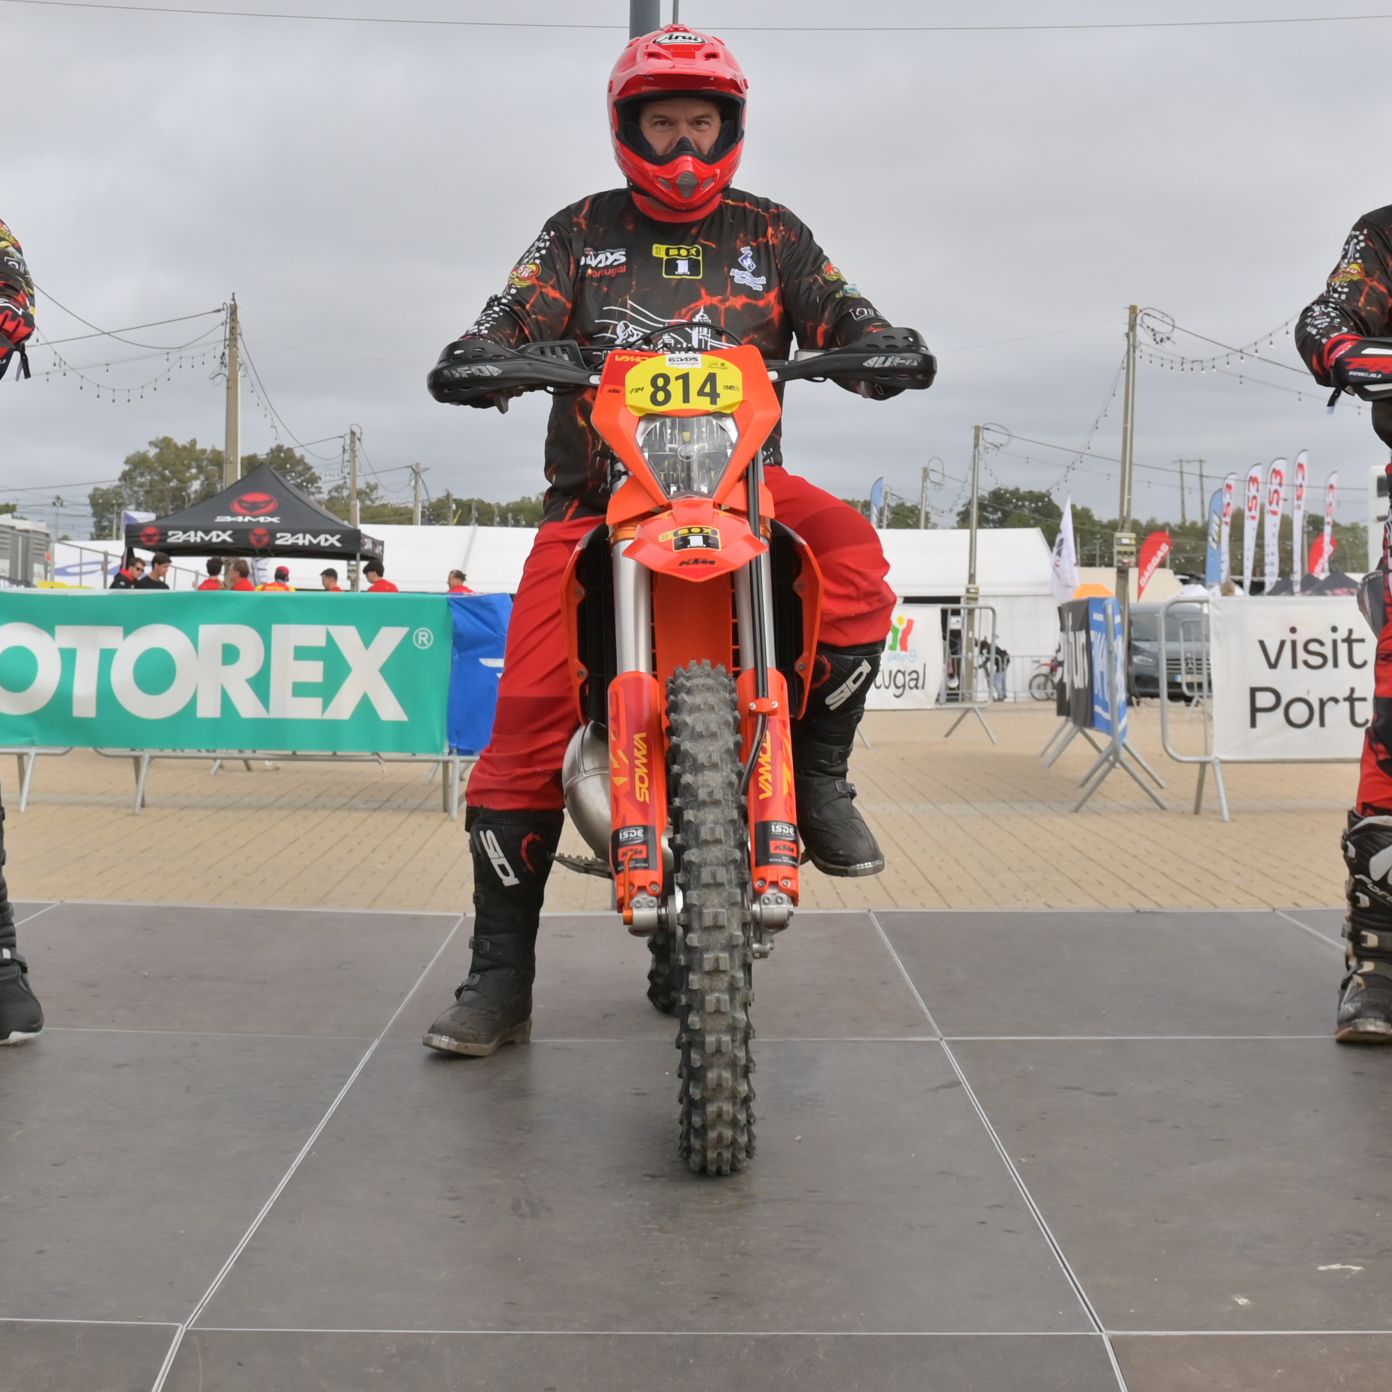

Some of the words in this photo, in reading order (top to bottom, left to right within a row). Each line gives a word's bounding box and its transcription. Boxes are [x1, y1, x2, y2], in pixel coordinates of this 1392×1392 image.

[650, 372, 721, 407] 814
[166, 530, 234, 543] 24MX
[275, 532, 342, 547] 24MX
[1139, 541, 1169, 587] GASGAS
[1258, 625, 1368, 670] visit
[872, 663, 927, 699] tugal
[1248, 686, 1370, 730] Port
[633, 732, 650, 804] VAMOS
